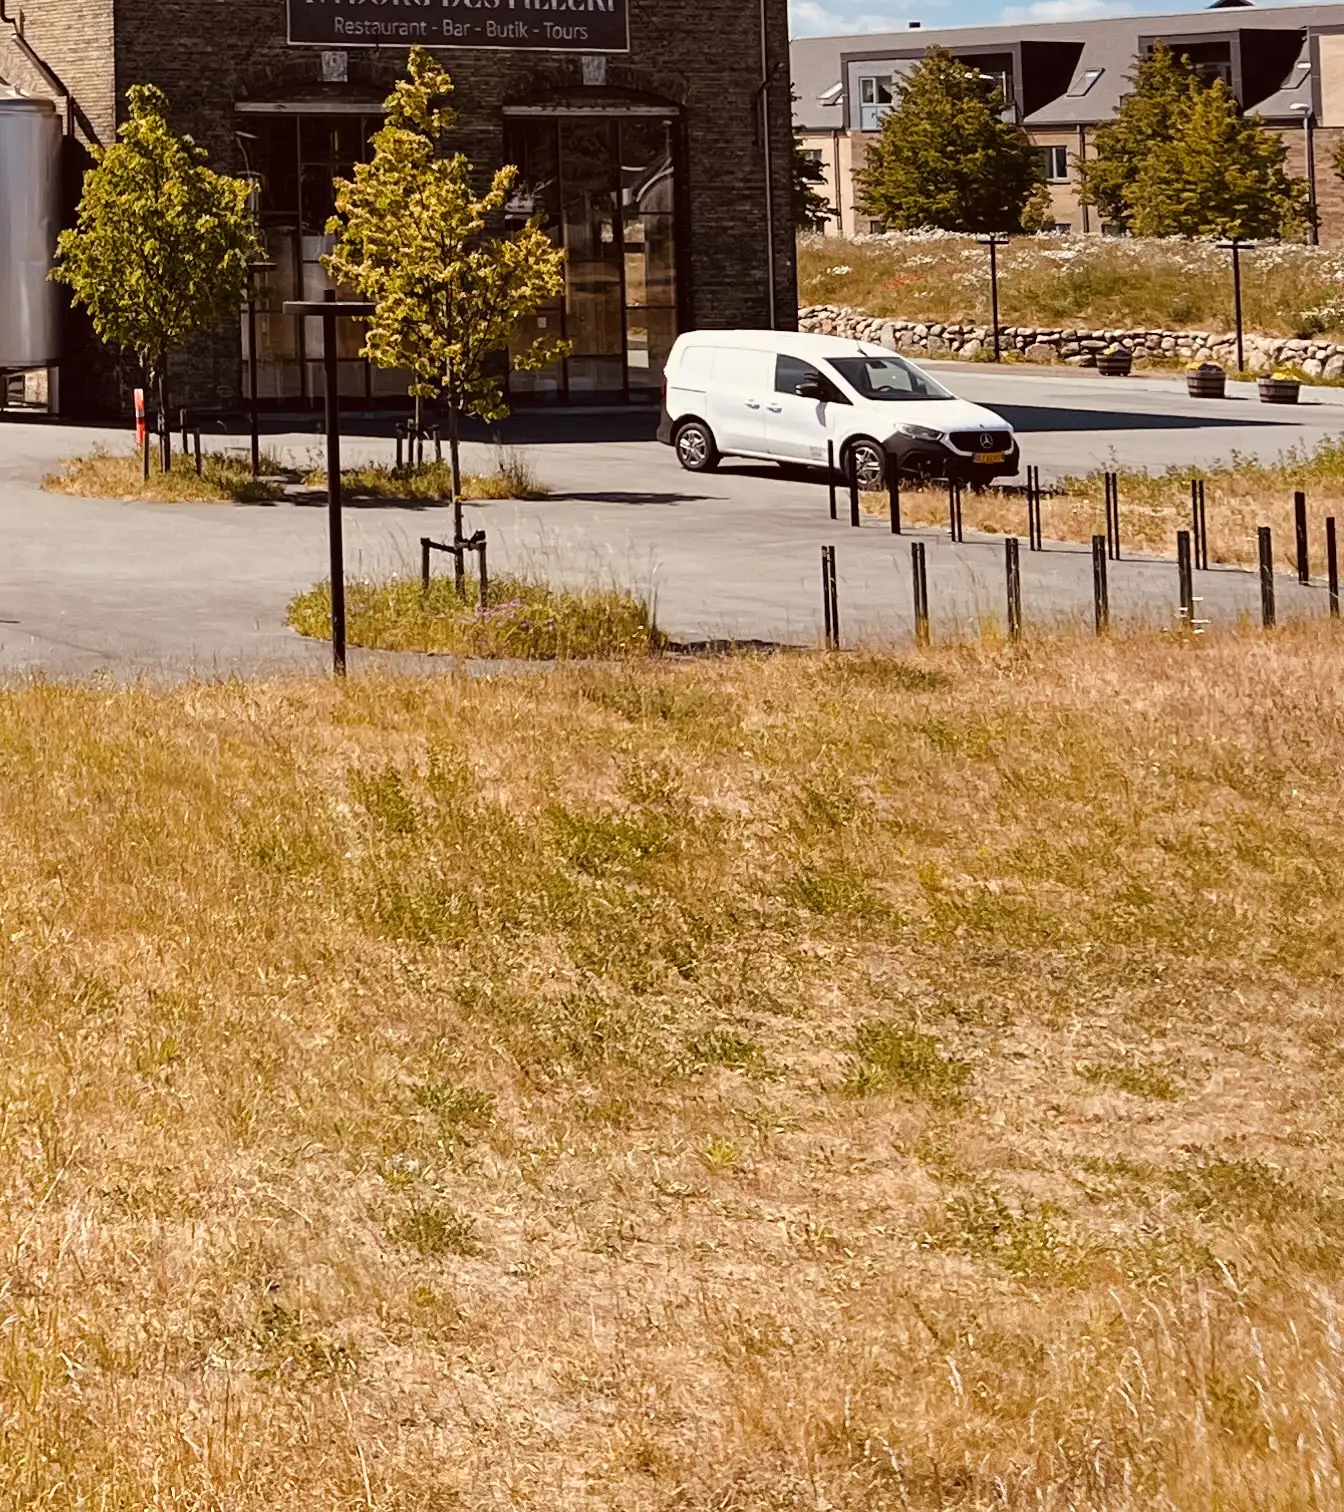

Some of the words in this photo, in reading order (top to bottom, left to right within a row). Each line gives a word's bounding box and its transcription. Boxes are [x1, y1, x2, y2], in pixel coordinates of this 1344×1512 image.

[334, 16, 427, 36] Restaurant
[442, 19, 470, 37] Bar
[486, 20, 528, 38] Butik
[543, 22, 588, 40] Tours
